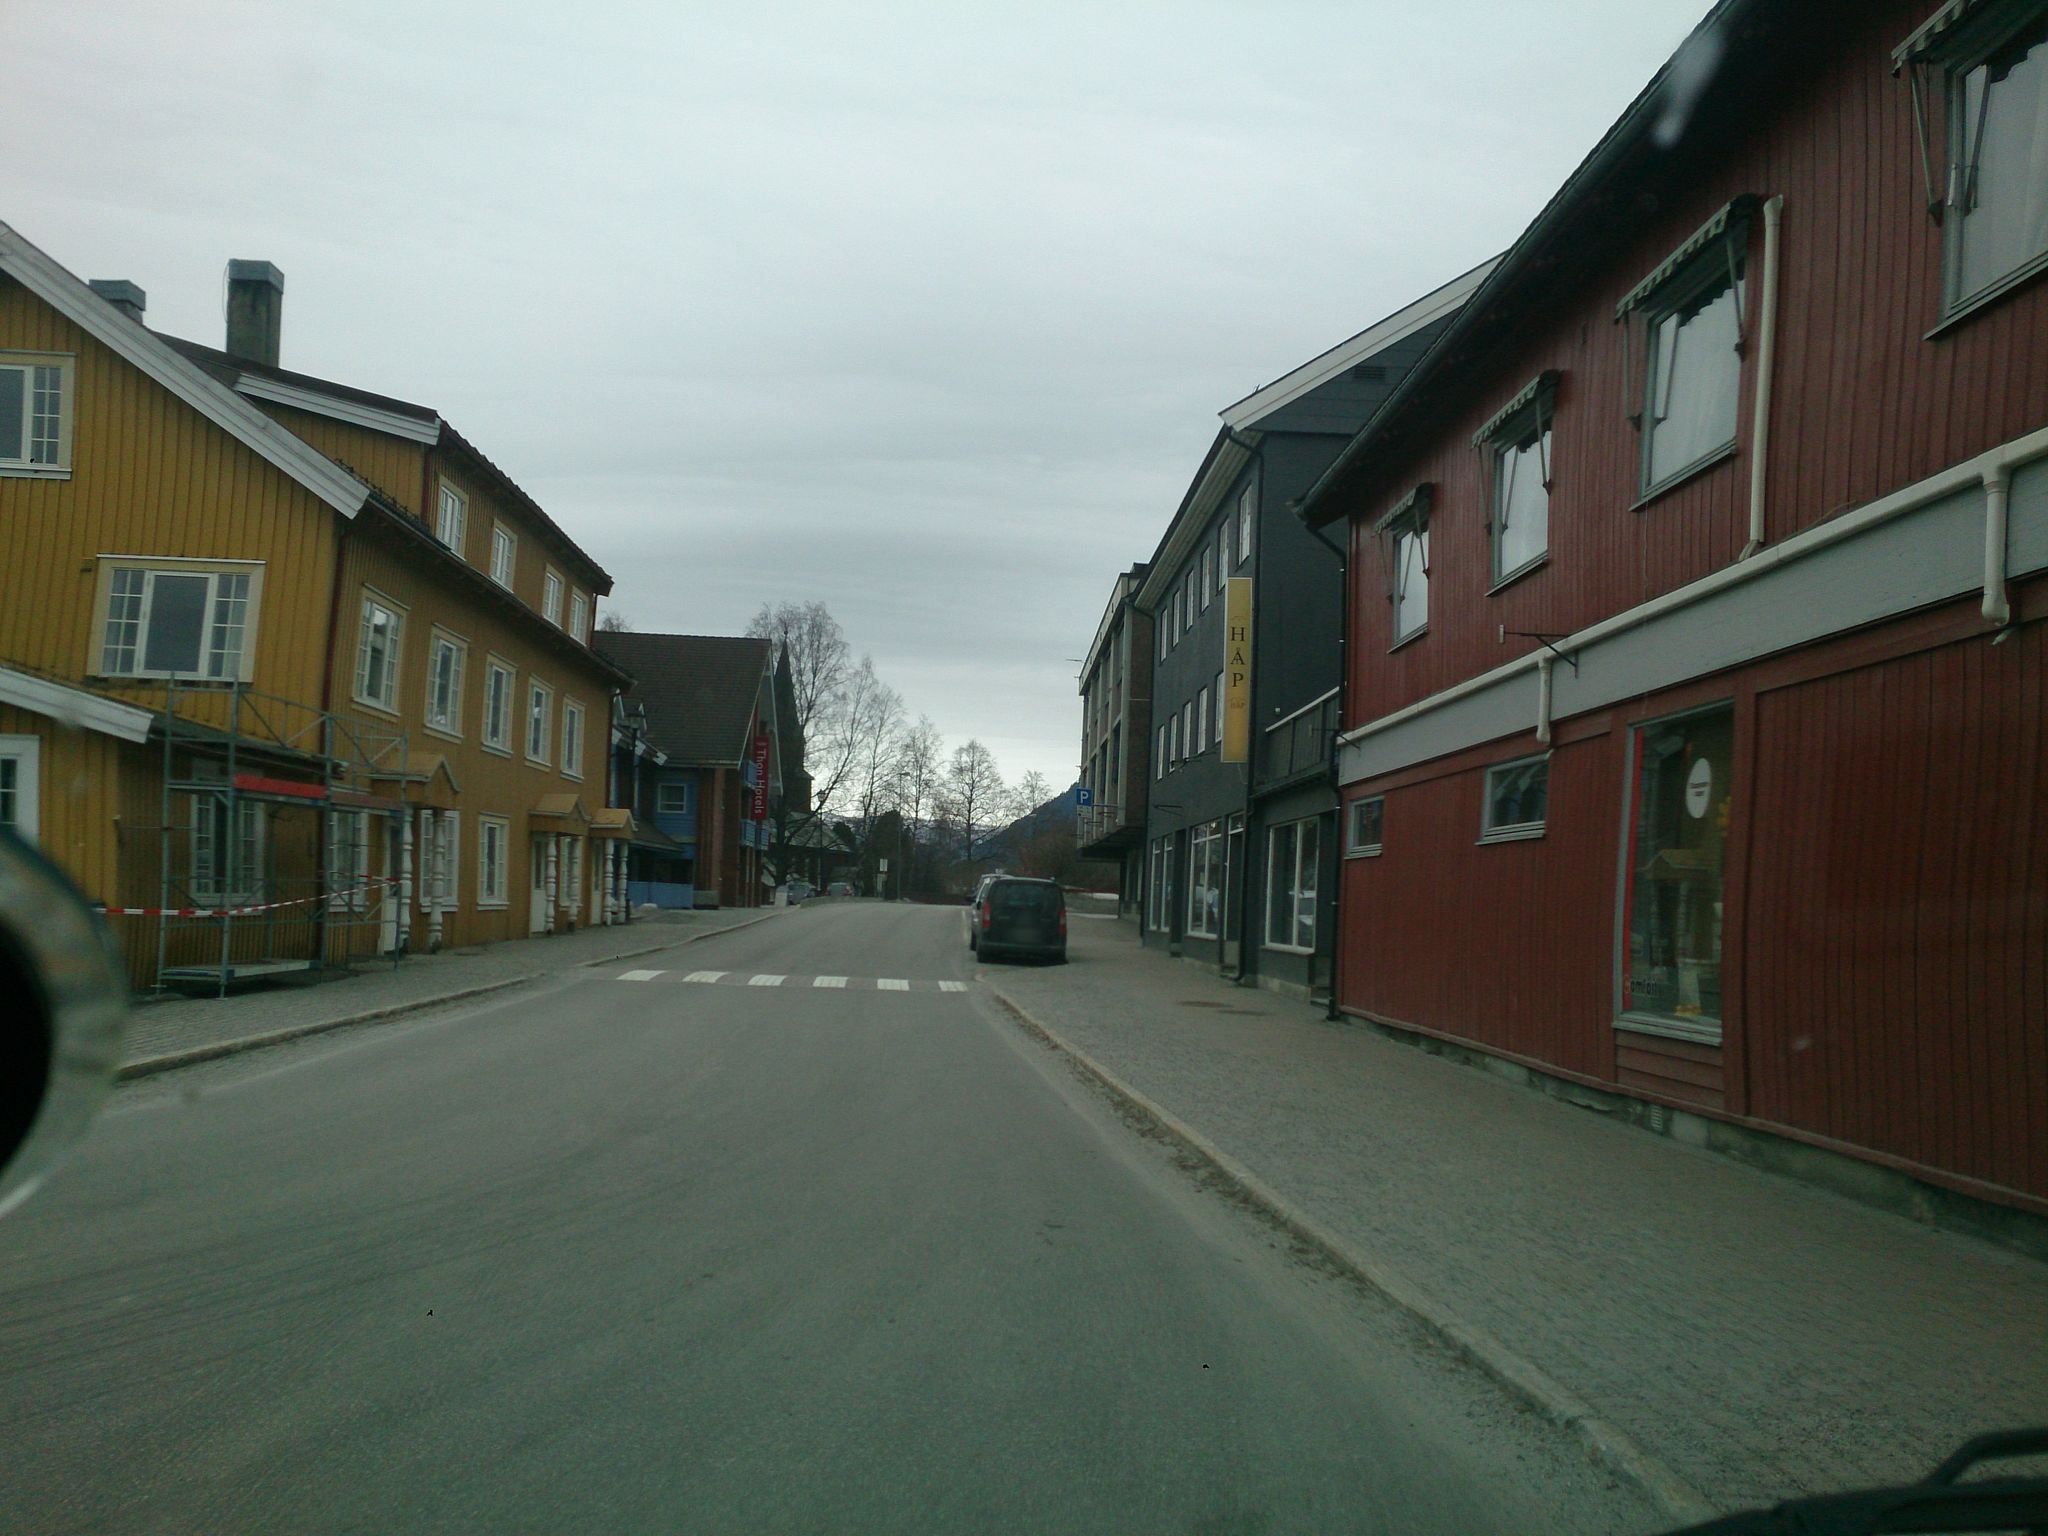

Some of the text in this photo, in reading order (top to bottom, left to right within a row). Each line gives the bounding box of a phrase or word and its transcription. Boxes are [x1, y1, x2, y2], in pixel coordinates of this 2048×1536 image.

[754, 748, 767, 814] Thon Hotels
[1080, 790, 1089, 804] P
